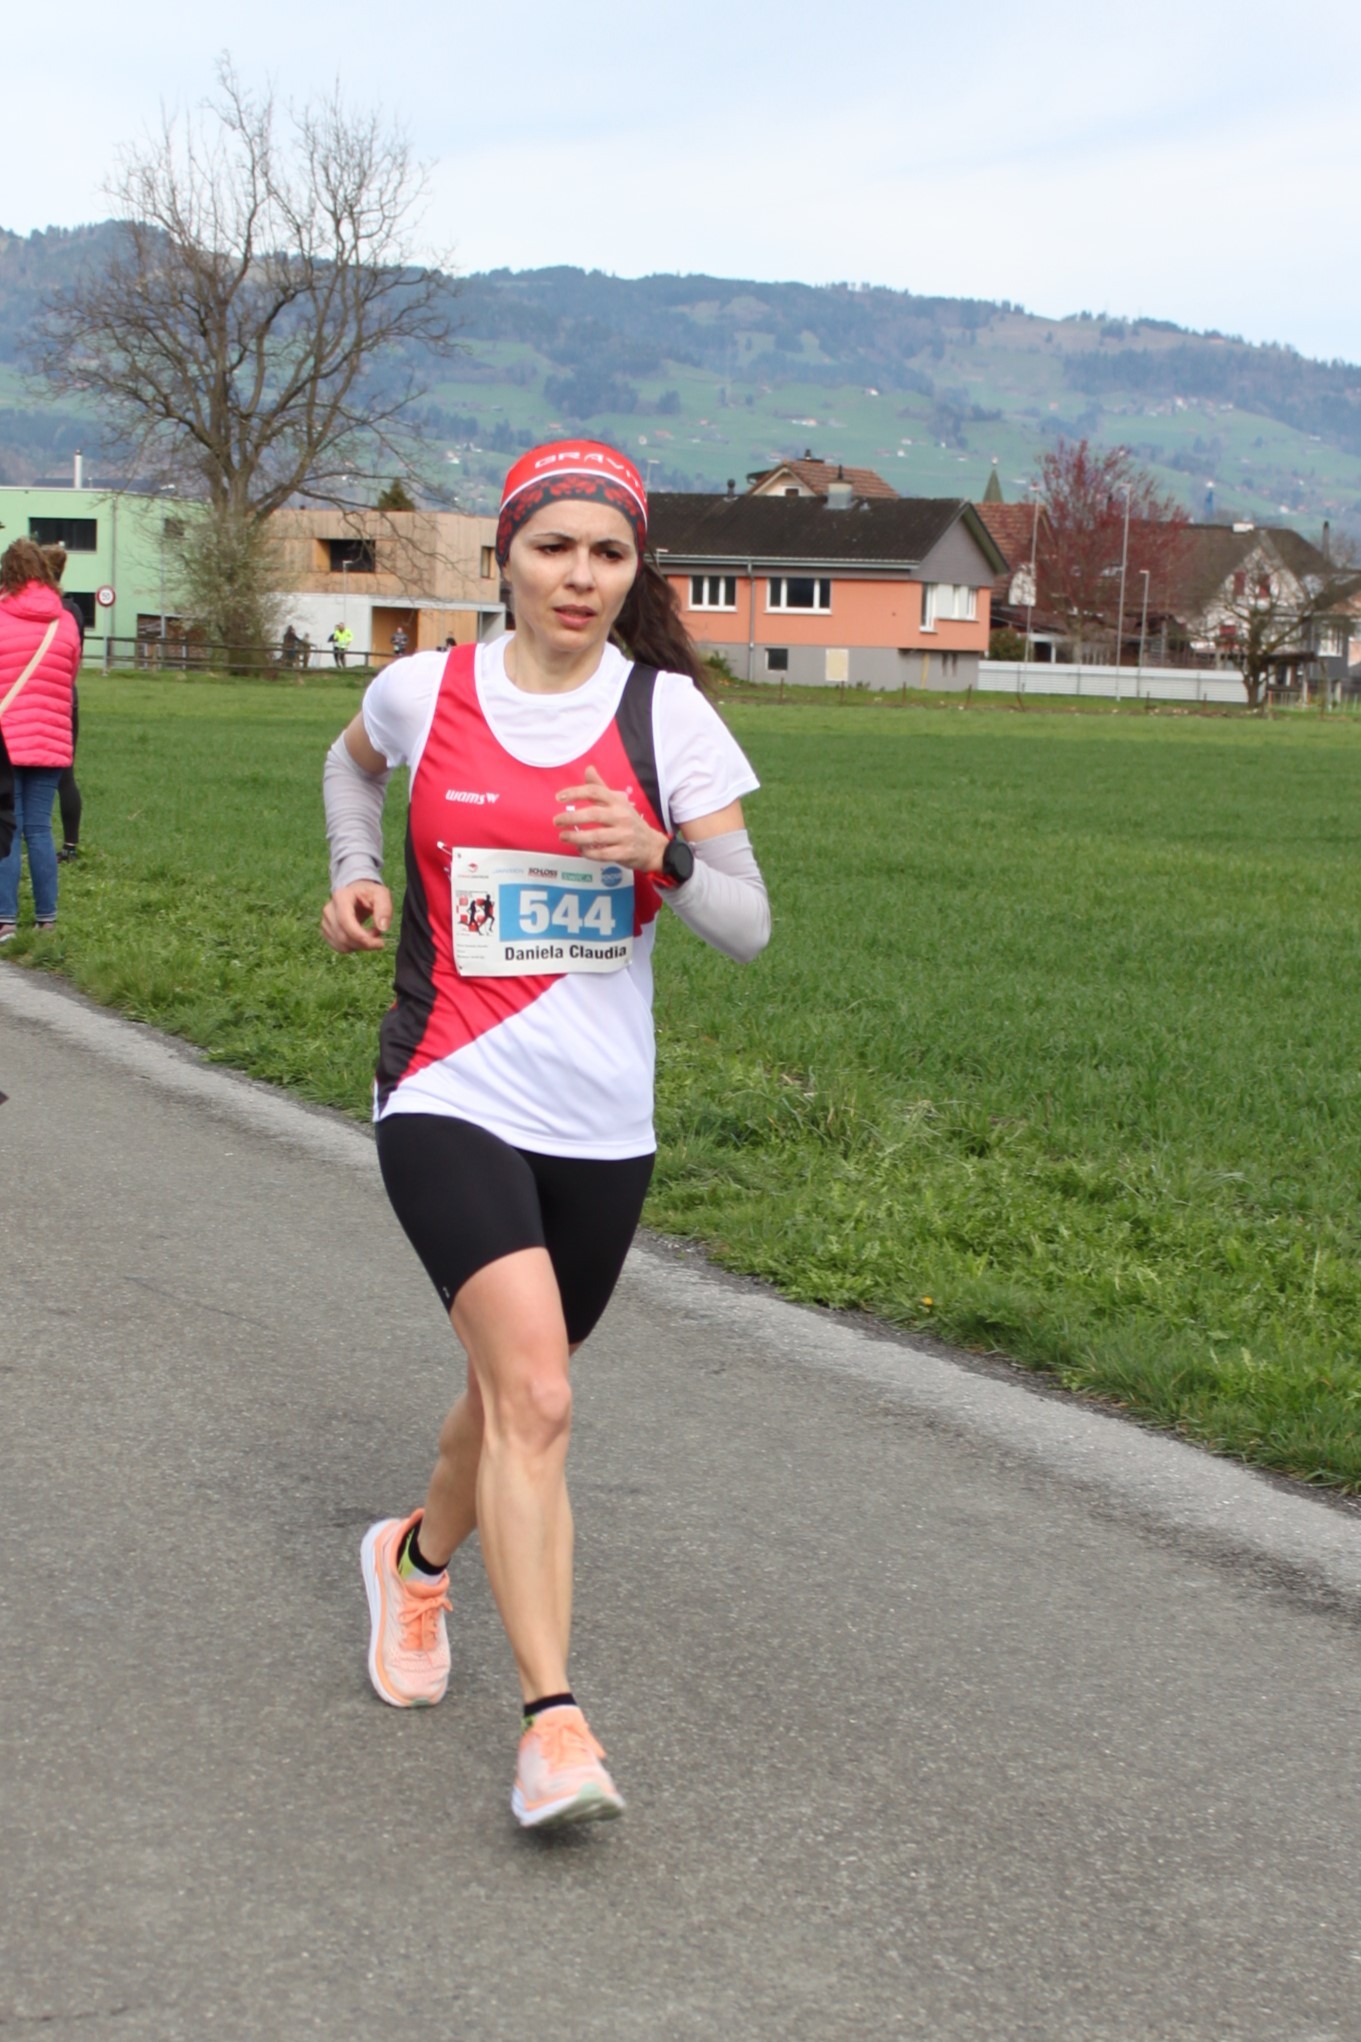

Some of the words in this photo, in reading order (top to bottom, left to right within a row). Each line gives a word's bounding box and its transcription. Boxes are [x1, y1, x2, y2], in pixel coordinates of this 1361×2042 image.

[519, 890, 616, 936] 544
[505, 945, 563, 961] Daniela
[569, 944, 627, 960] Claudia
